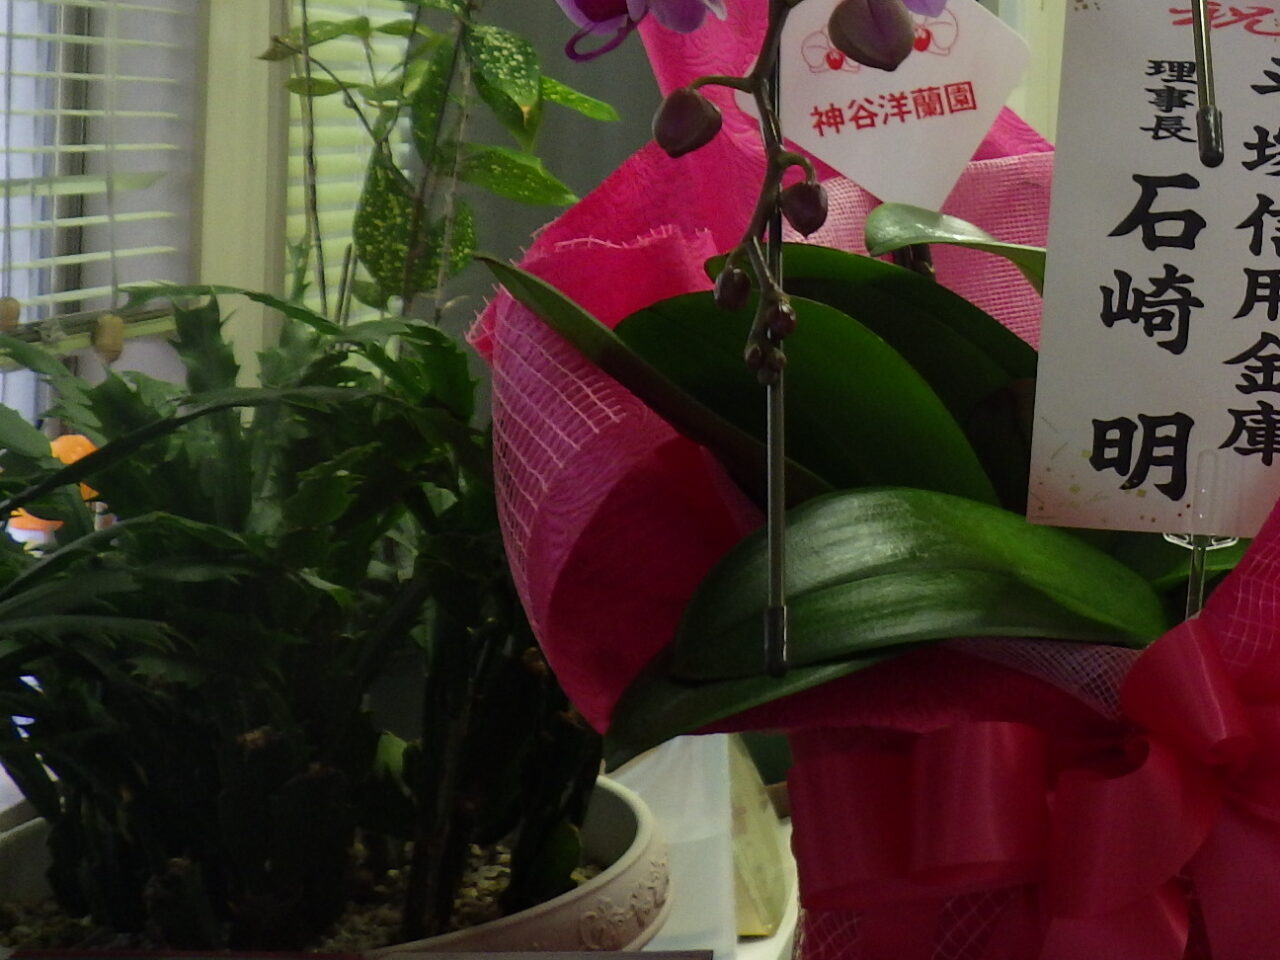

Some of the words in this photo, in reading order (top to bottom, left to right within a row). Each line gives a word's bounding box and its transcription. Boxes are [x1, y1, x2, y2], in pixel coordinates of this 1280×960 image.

[810, 81, 978, 137] 神谷洋蘭園
[1139, 59, 1198, 143] 理事長
